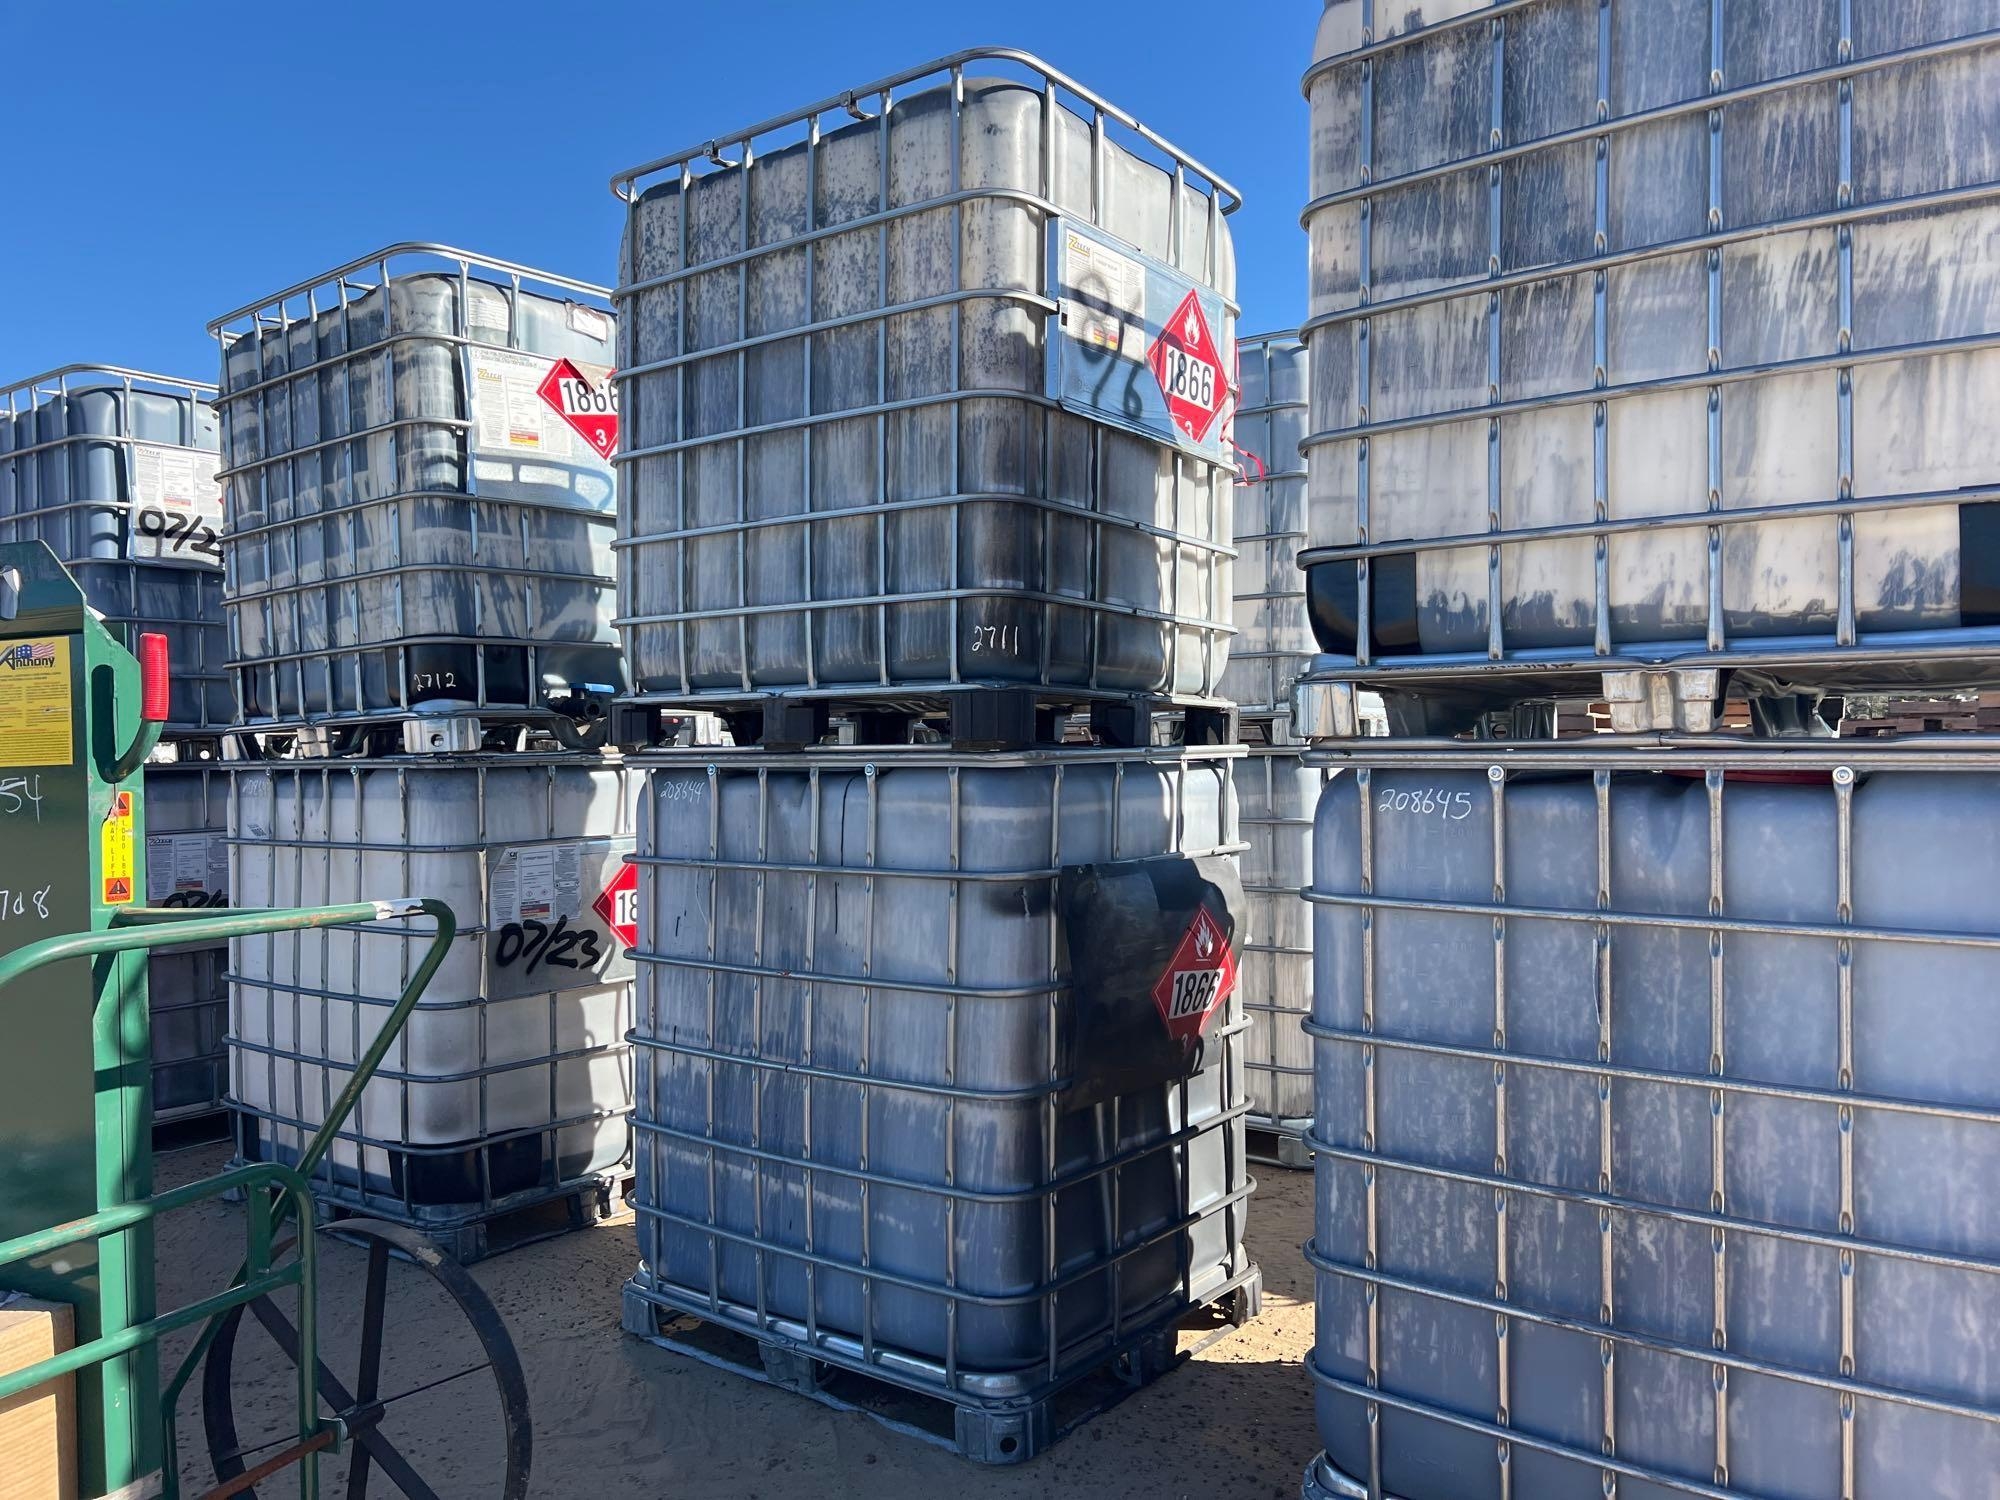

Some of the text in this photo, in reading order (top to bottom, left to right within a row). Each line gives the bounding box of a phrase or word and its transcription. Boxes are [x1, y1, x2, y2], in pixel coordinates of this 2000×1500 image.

[1168, 349, 1213, 407] 1866
[595, 428, 607, 447] 3
[139, 507, 225, 563] 07/2
[972, 625, 1018, 655] 2711
[0, 643, 55, 671] Anthony
[414, 673, 457, 691] 2712
[660, 780, 705, 804] 208644
[1378, 788, 1472, 820] 208645
[495, 913, 601, 975] 07/23
[1174, 970, 1221, 1018] 1866
